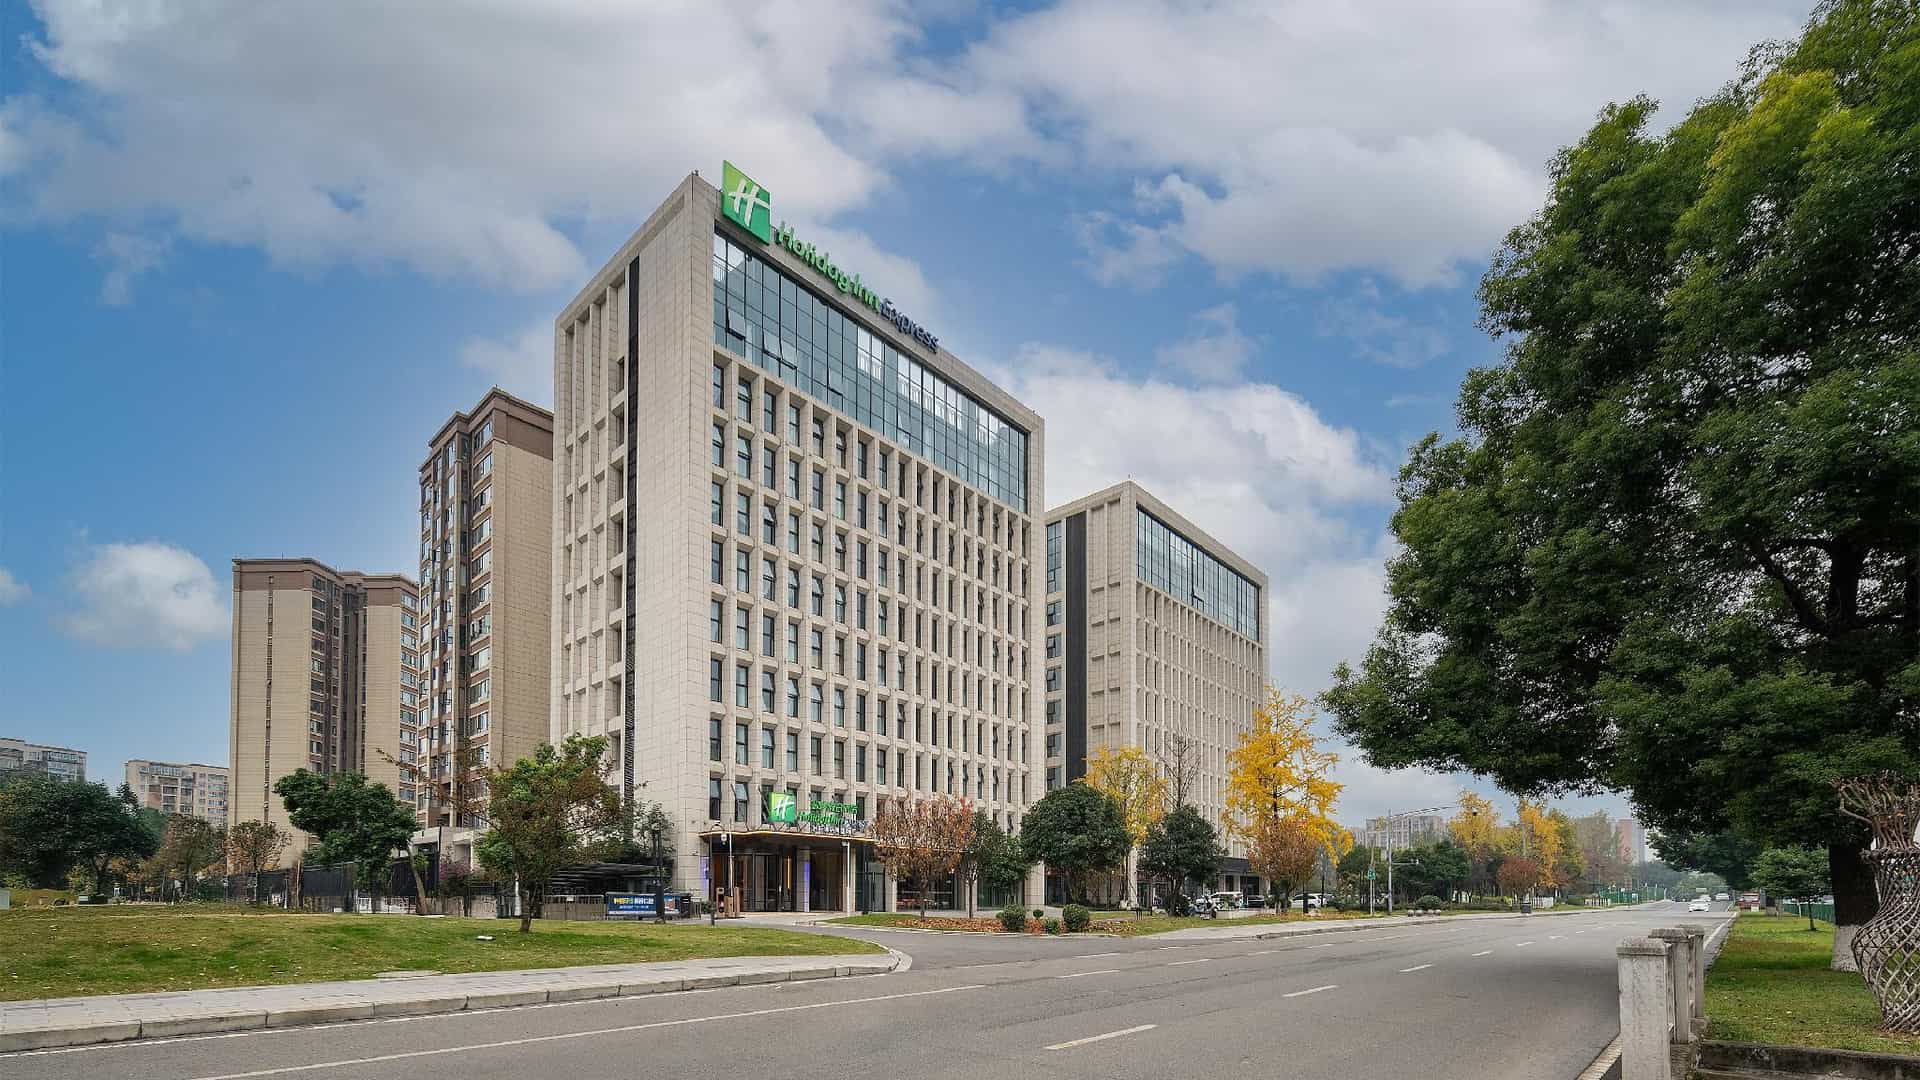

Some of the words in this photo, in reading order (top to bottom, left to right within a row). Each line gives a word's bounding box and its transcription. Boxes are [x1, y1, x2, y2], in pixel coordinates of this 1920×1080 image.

[777, 221, 850, 293] Holiday
[851, 272, 881, 313] Inn
[879, 298, 939, 354] Express
